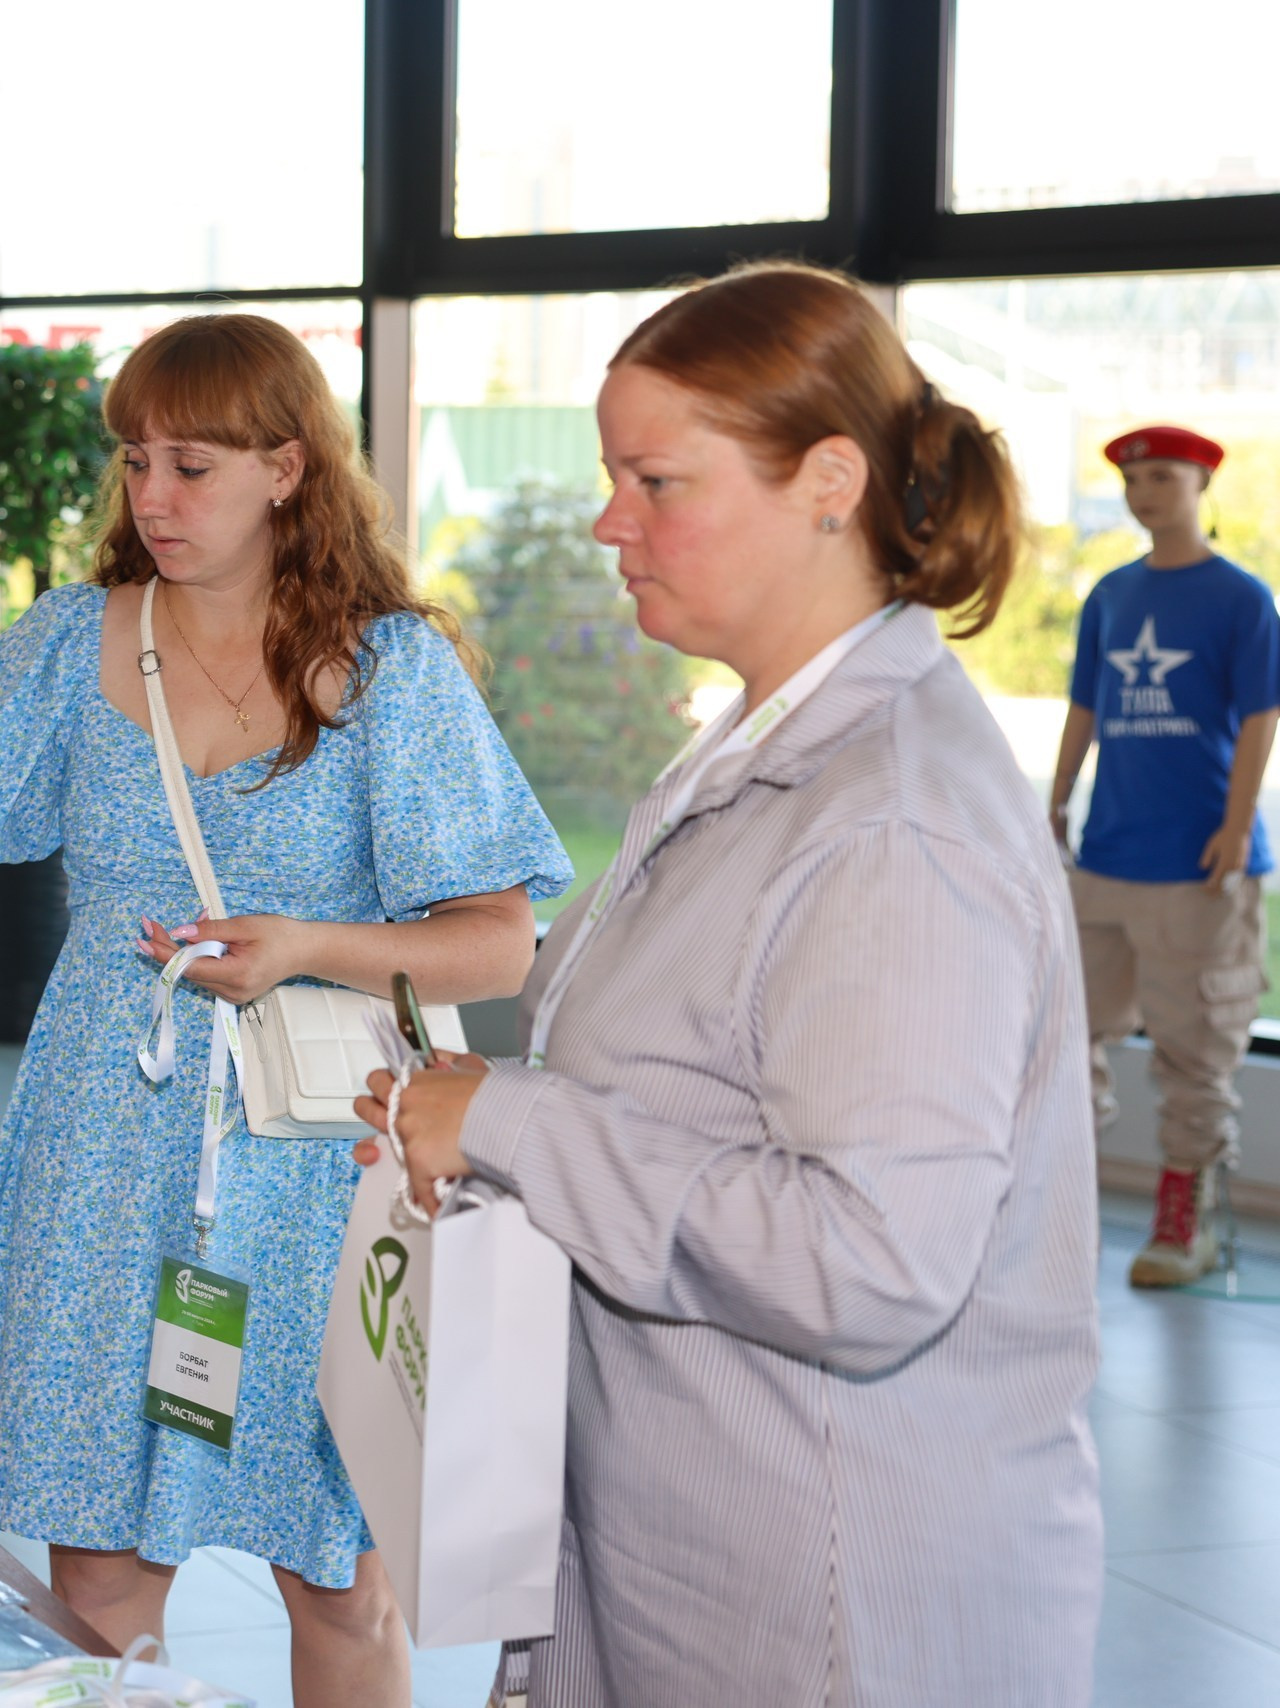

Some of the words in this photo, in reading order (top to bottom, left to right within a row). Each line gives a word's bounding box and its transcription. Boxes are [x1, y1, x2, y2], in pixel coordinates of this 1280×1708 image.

[213, 1096, 221, 1126] ПАРКОВЫЙ
[190, 1279, 228, 1298] ПАРКОВЫЙ
[190, 1288, 215, 1301] ФОРУМ
[179, 1352, 209, 1368] БОРБАТ
[176, 1364, 209, 1382] ЕВГЕНИЯ
[160, 1400, 215, 1432] УЧАСТНИК
